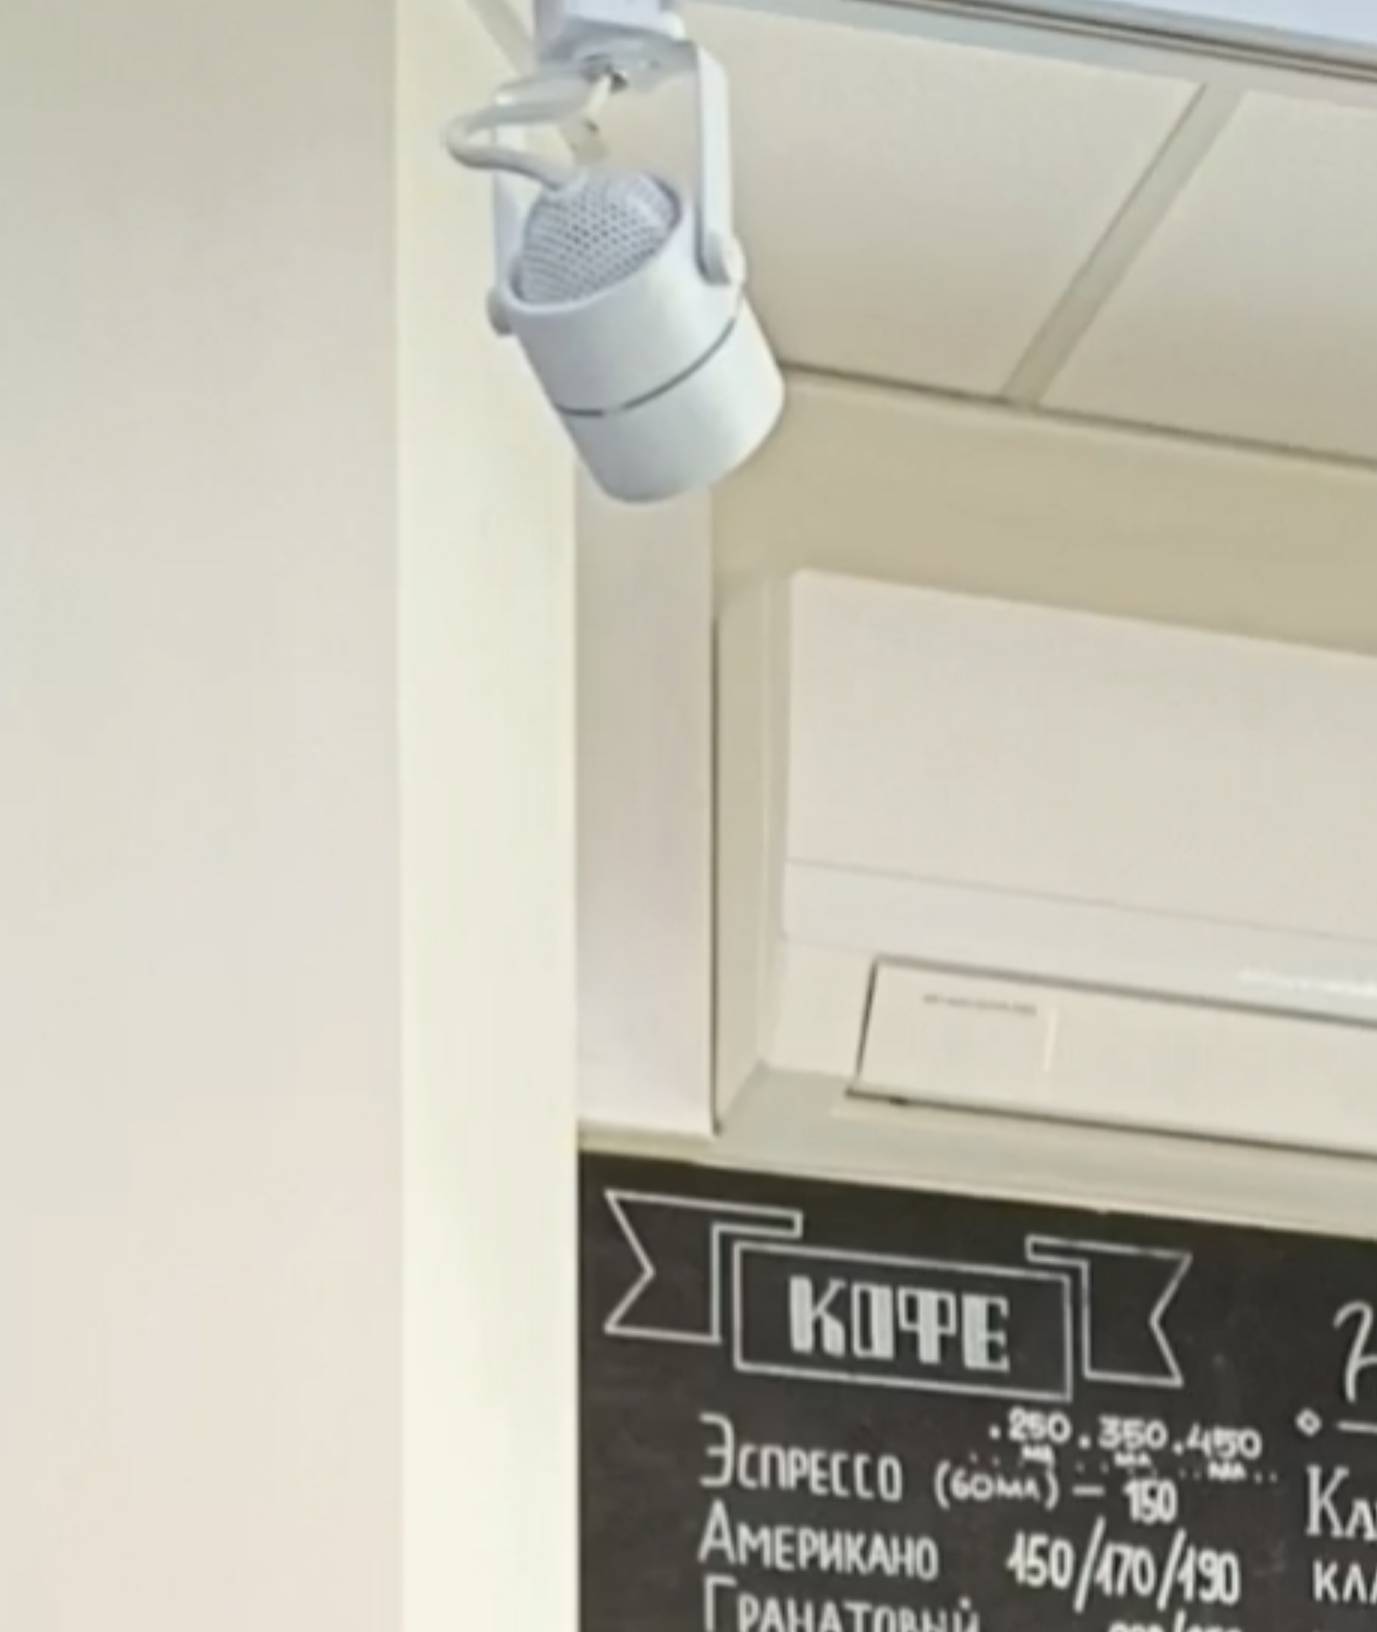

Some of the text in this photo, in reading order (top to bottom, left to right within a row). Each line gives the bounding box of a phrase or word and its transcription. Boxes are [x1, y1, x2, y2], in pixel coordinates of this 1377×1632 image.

[790, 1276, 1009, 1373] КОФЕ
[700, 1413, 901, 1501] ЭСПРЕССО
[1123, 1479, 1176, 1522] 150
[699, 1501, 938, 1580] АМЕРИКАНО
